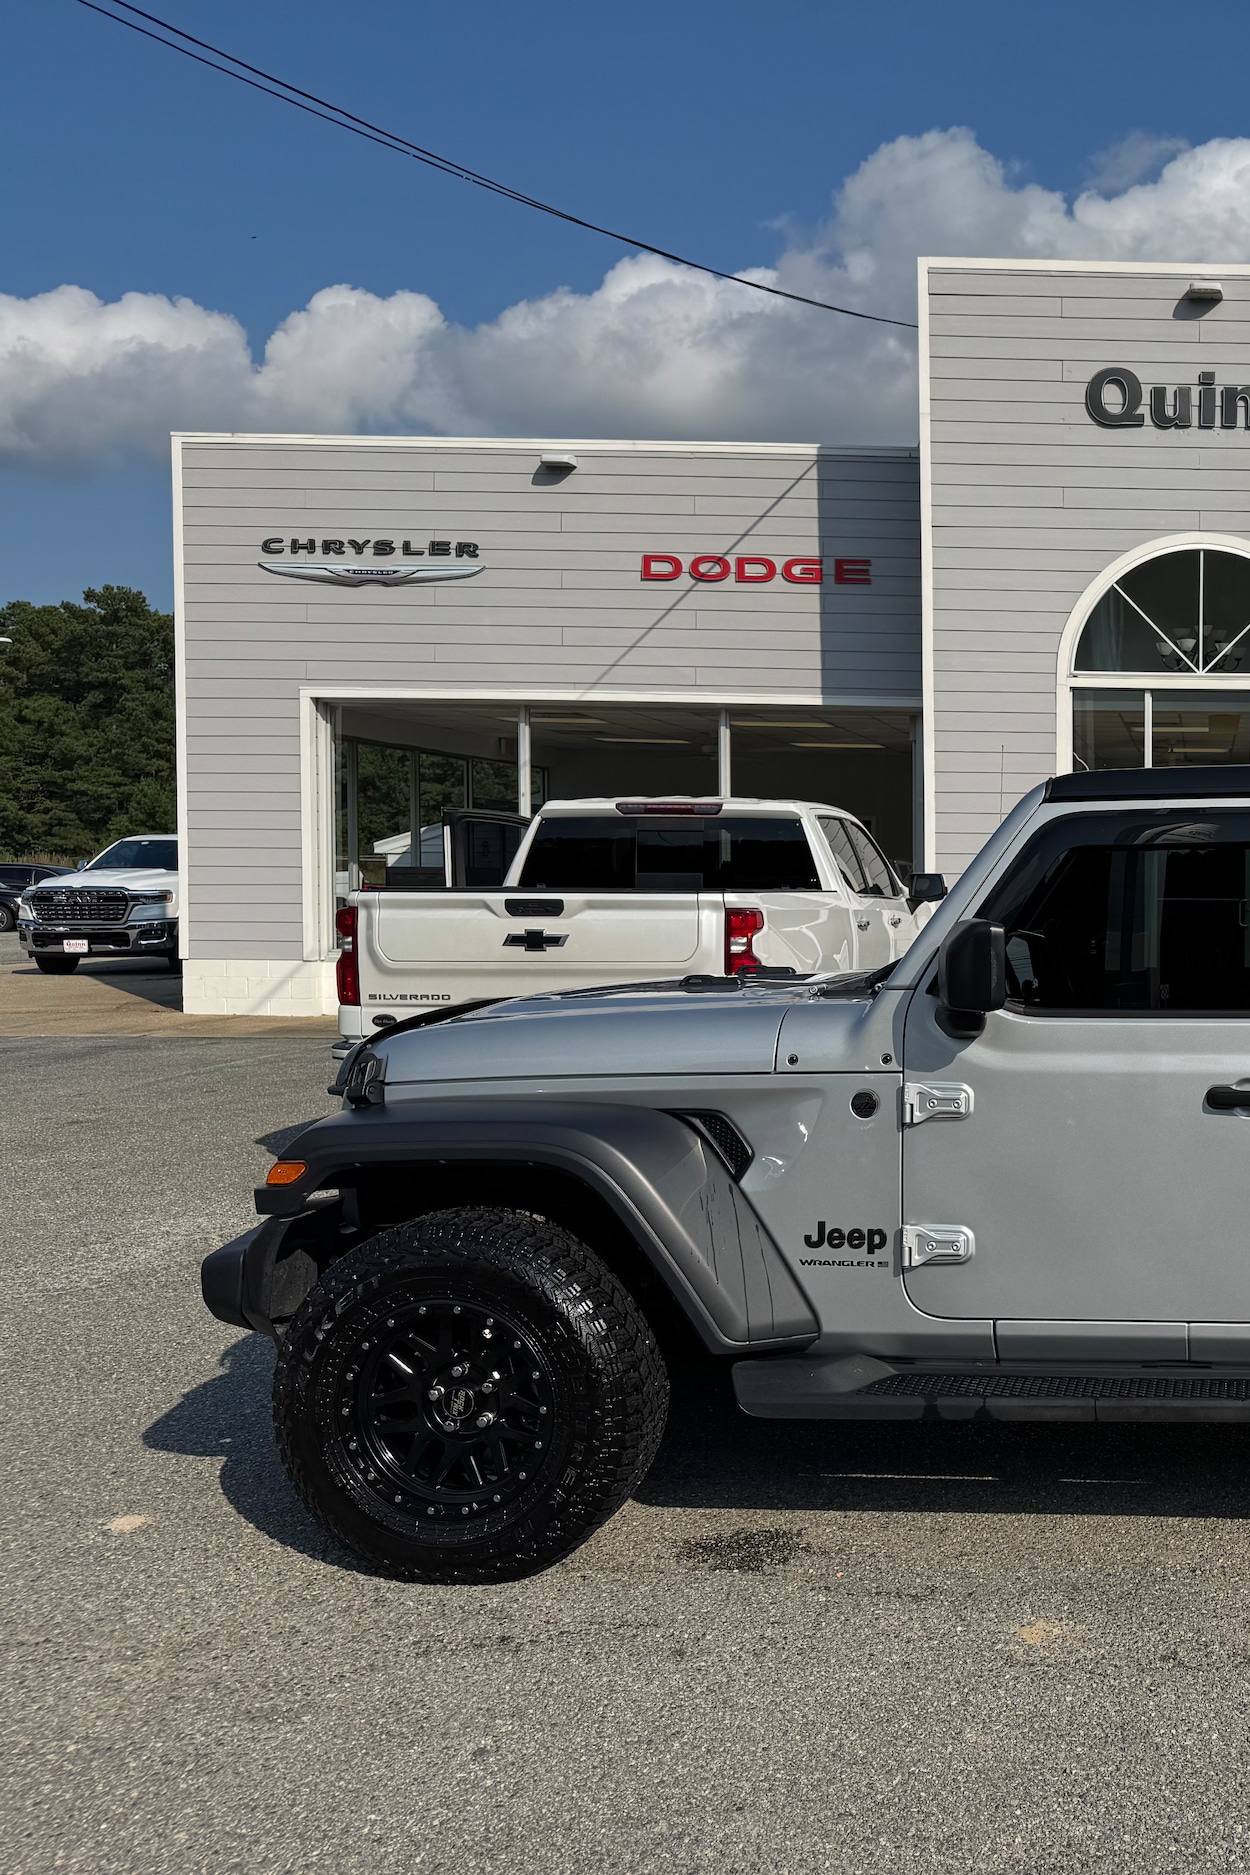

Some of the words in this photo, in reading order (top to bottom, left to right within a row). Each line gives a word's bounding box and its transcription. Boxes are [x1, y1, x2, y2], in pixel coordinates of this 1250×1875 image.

[261, 537, 480, 558] CHRYSLER
[641, 554, 872, 584] DODGE
[368, 993, 451, 1001] SILVERADO
[804, 1221, 887, 1254] Jeep
[799, 1259, 875, 1267] WRANGLER
